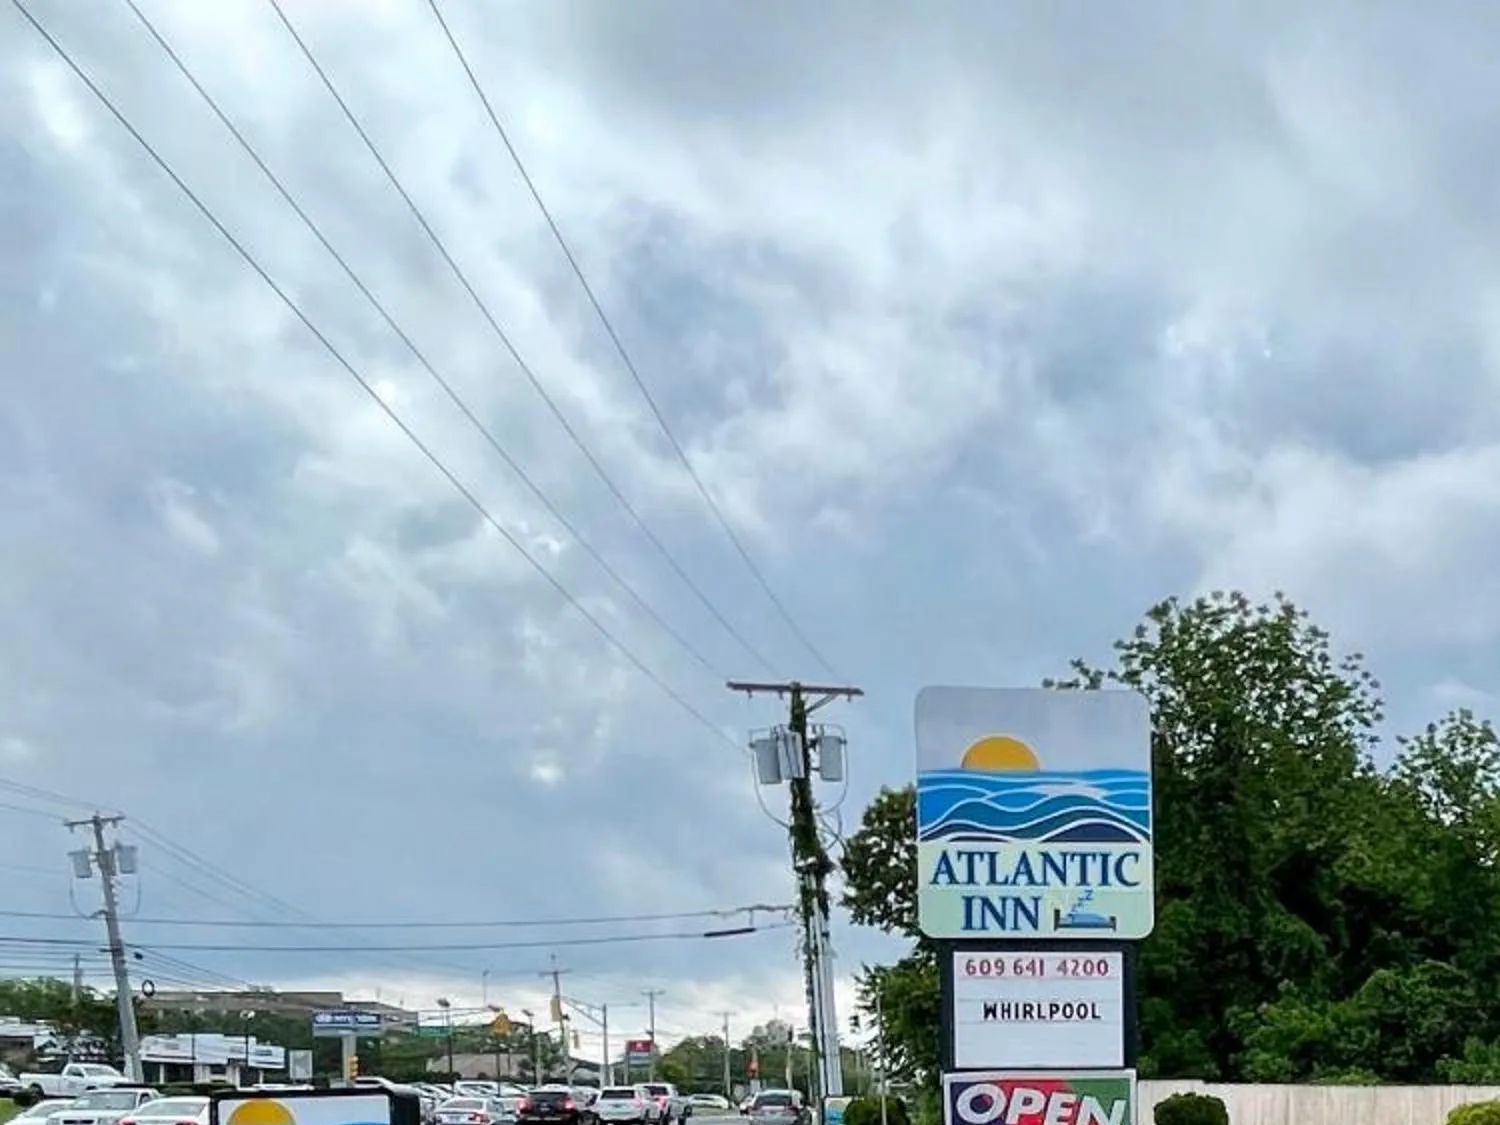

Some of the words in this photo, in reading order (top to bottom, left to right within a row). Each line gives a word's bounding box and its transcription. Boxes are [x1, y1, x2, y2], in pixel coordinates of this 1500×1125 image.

[929, 850, 1141, 887] ATLANTIC
[961, 896, 1044, 931] INN
[965, 958, 1005, 977] 609
[1013, 958, 1045, 977] 641
[1056, 958, 1109, 977] 4200
[983, 1002, 1101, 1020] WHIRLPOOL
